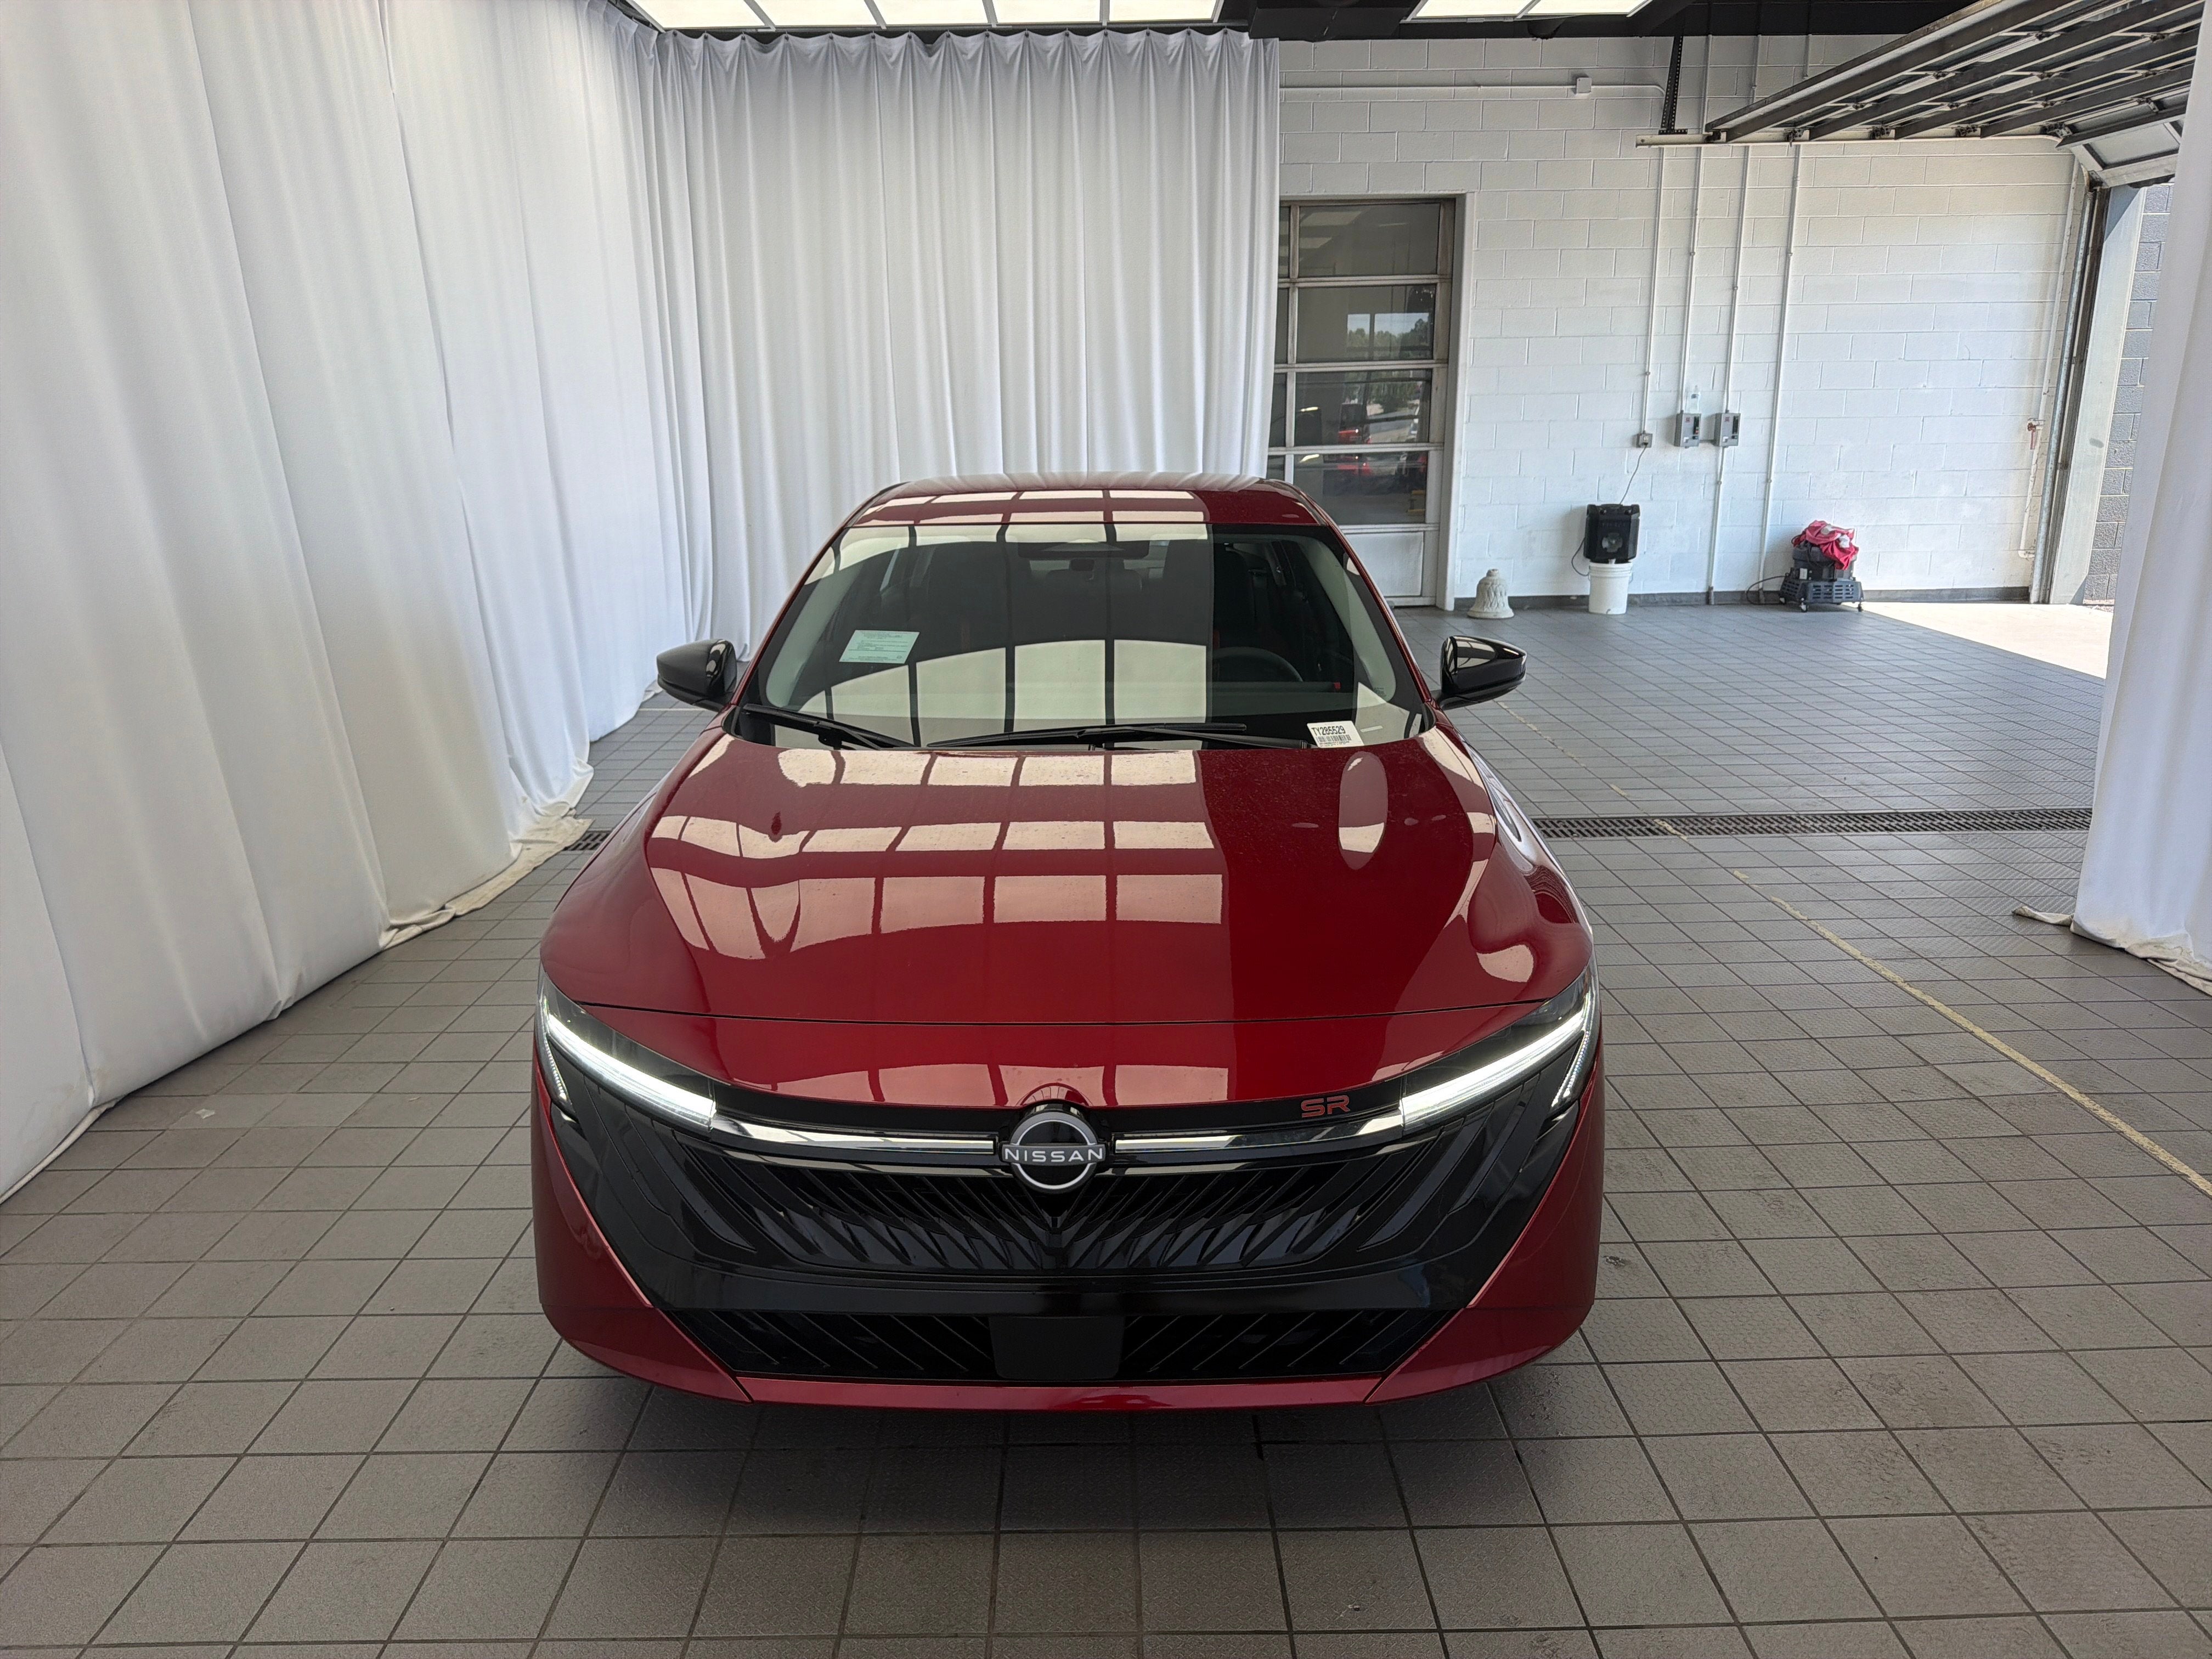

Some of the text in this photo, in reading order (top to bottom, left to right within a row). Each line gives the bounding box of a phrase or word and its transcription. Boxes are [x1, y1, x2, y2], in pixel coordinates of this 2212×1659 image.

[1311, 725, 1346, 736] TY285529
[1301, 1095, 1350, 1118] SR
[1005, 1148, 1103, 1162] NISSAN
